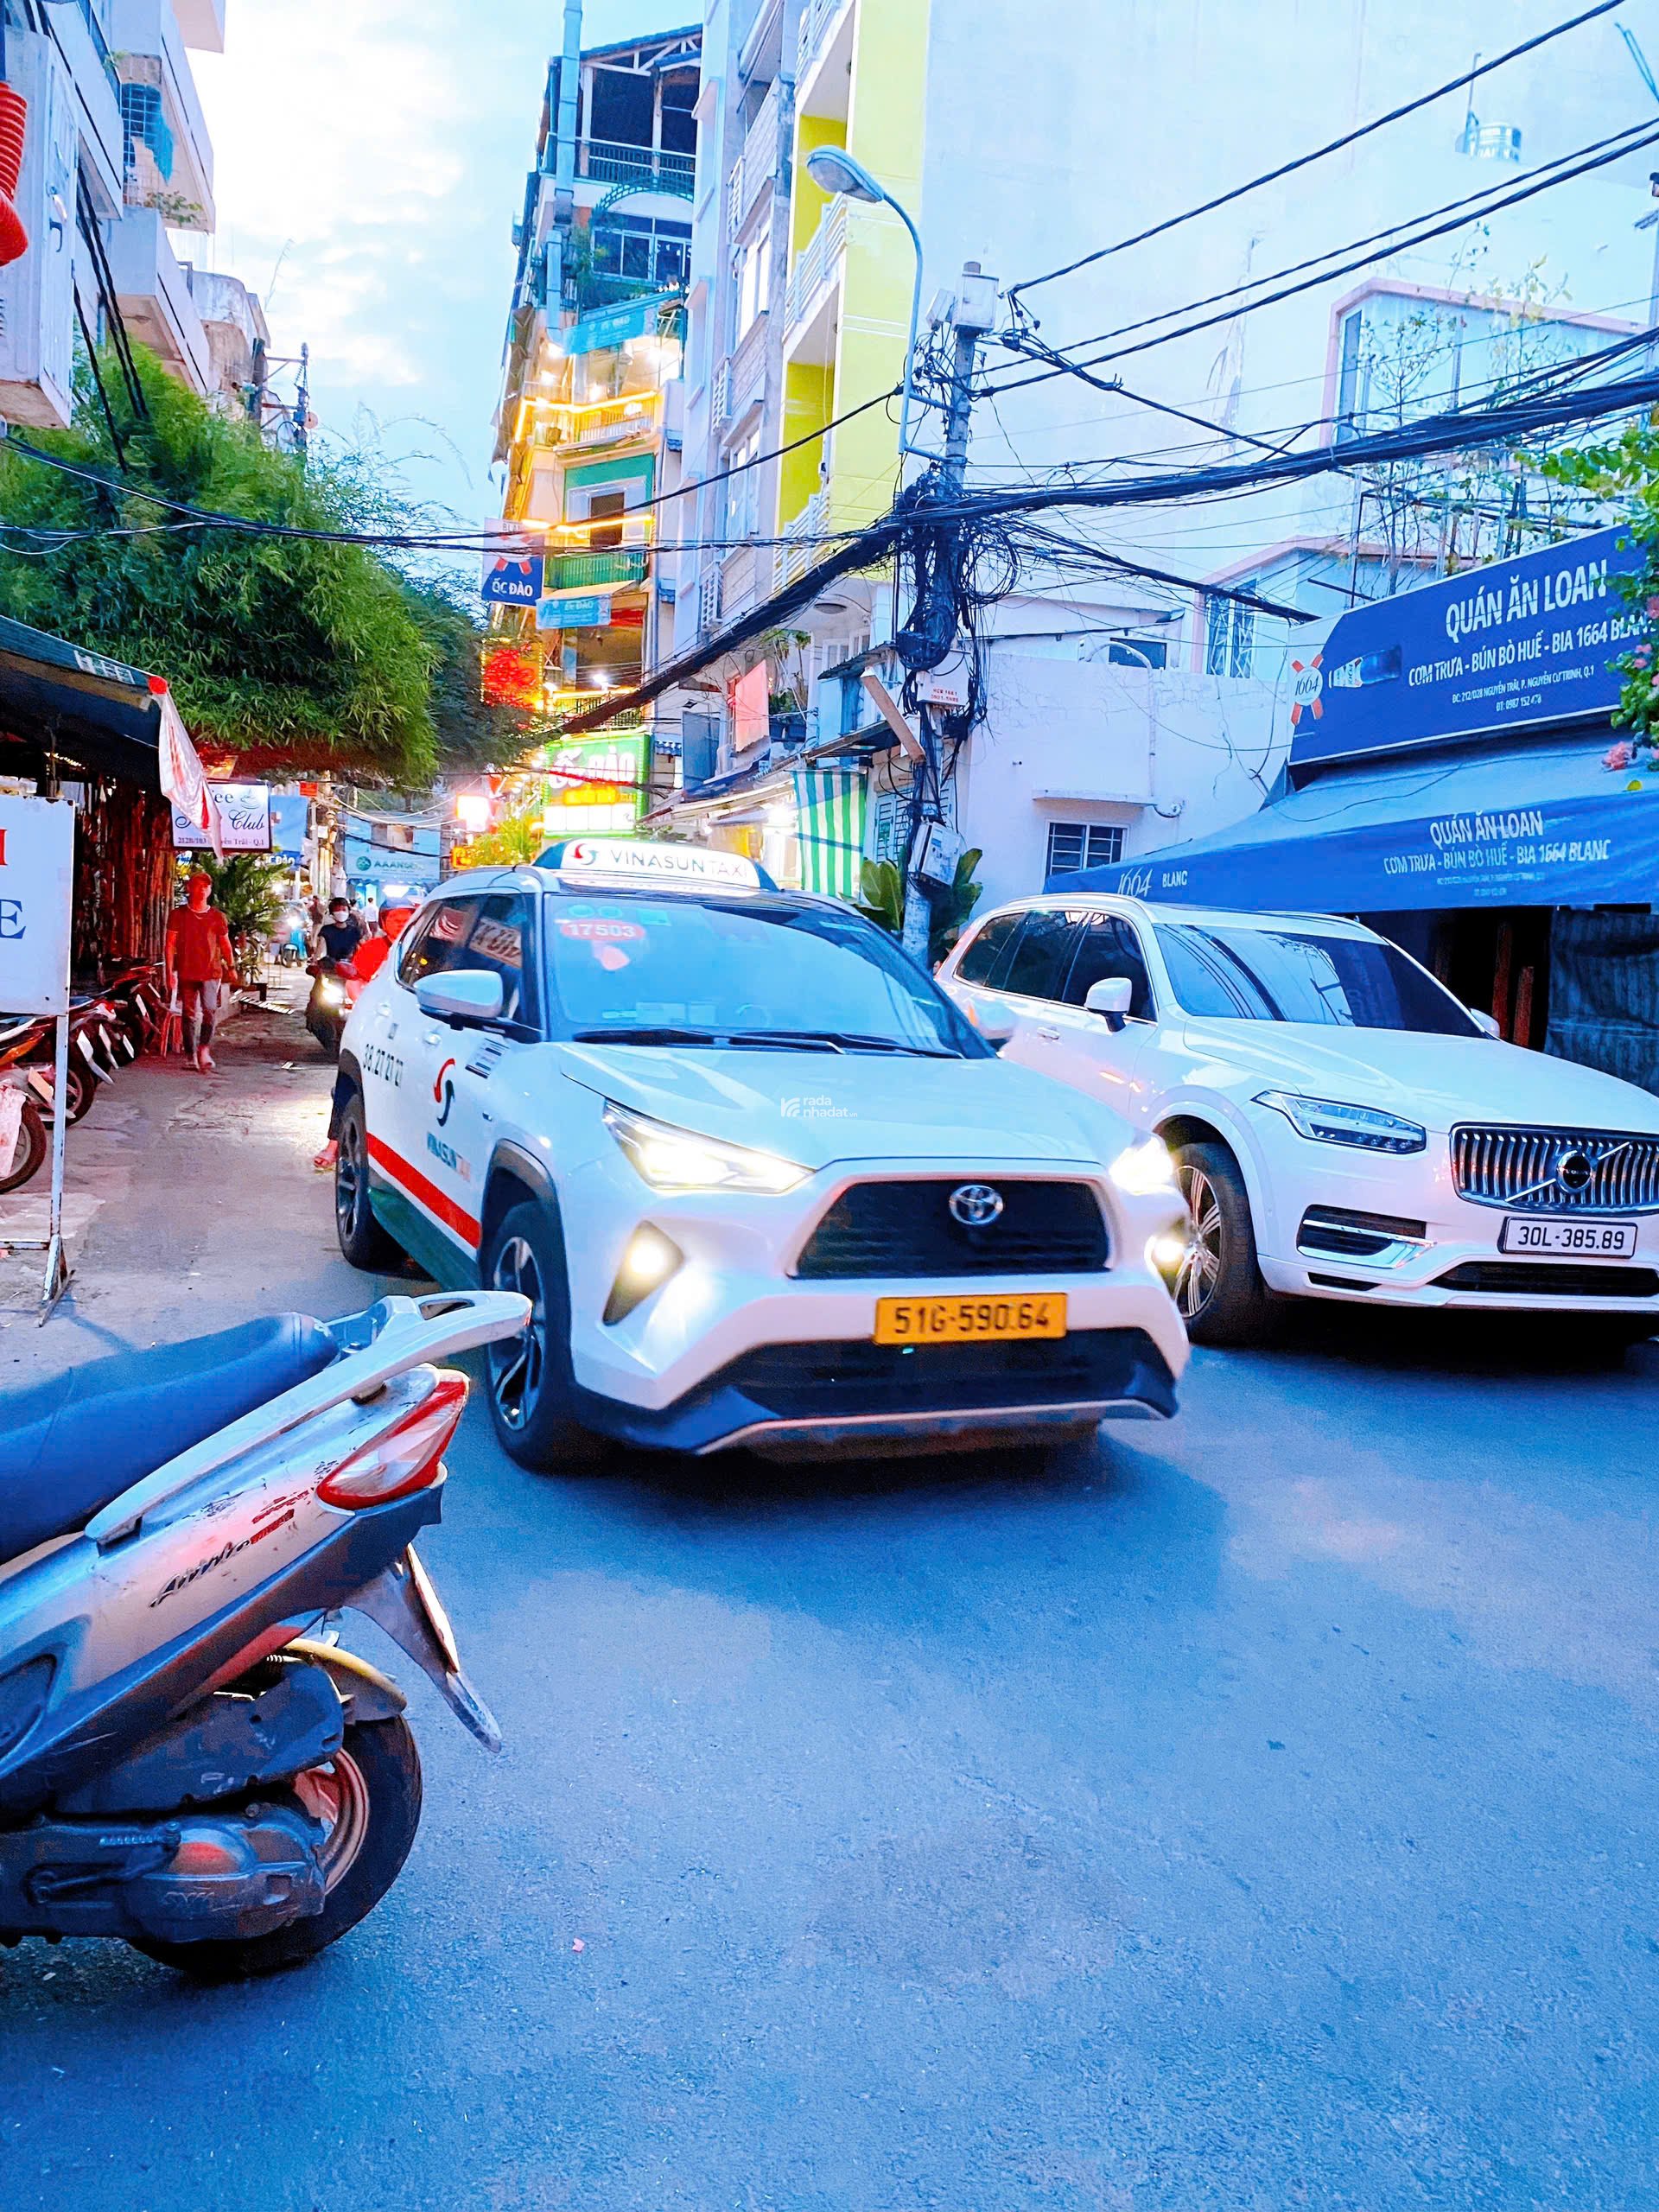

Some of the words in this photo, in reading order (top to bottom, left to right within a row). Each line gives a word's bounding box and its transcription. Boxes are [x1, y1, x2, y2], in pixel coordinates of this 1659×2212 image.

[509, 581, 533, 596] ĐÀO
[1446, 586, 1502, 644] QUÁN
[1506, 575, 1538, 622] ĂN
[1544, 559, 1607, 612] LOAN
[1471, 645, 1496, 673] BÚN
[1499, 639, 1515, 665] BÒ
[1517, 629, 1544, 663] HUẾ
[1552, 630, 1573, 654] BIA
[1577, 620, 1608, 648] 1664
[228, 810, 264, 830] Club
[1430, 814, 1472, 850] QUÁN
[1476, 810, 1497, 842] ĂN
[1499, 810, 1543, 839] LOAN
[611, 849, 704, 873] VINASUN
[709, 860, 747, 877] TAXI
[1444, 846, 1466, 869] BÚN
[1469, 843, 1484, 868] BÒ
[1486, 841, 1508, 866] HUẾ
[1517, 846, 1536, 864] BIA
[1538, 844, 1566, 863] 1664
[1568, 839, 1611, 862] BLANC
[1162, 870, 1188, 887] BLANC
[569, 923, 636, 938] 17503
[1517, 1225, 1625, 1250] 30L-385.89
